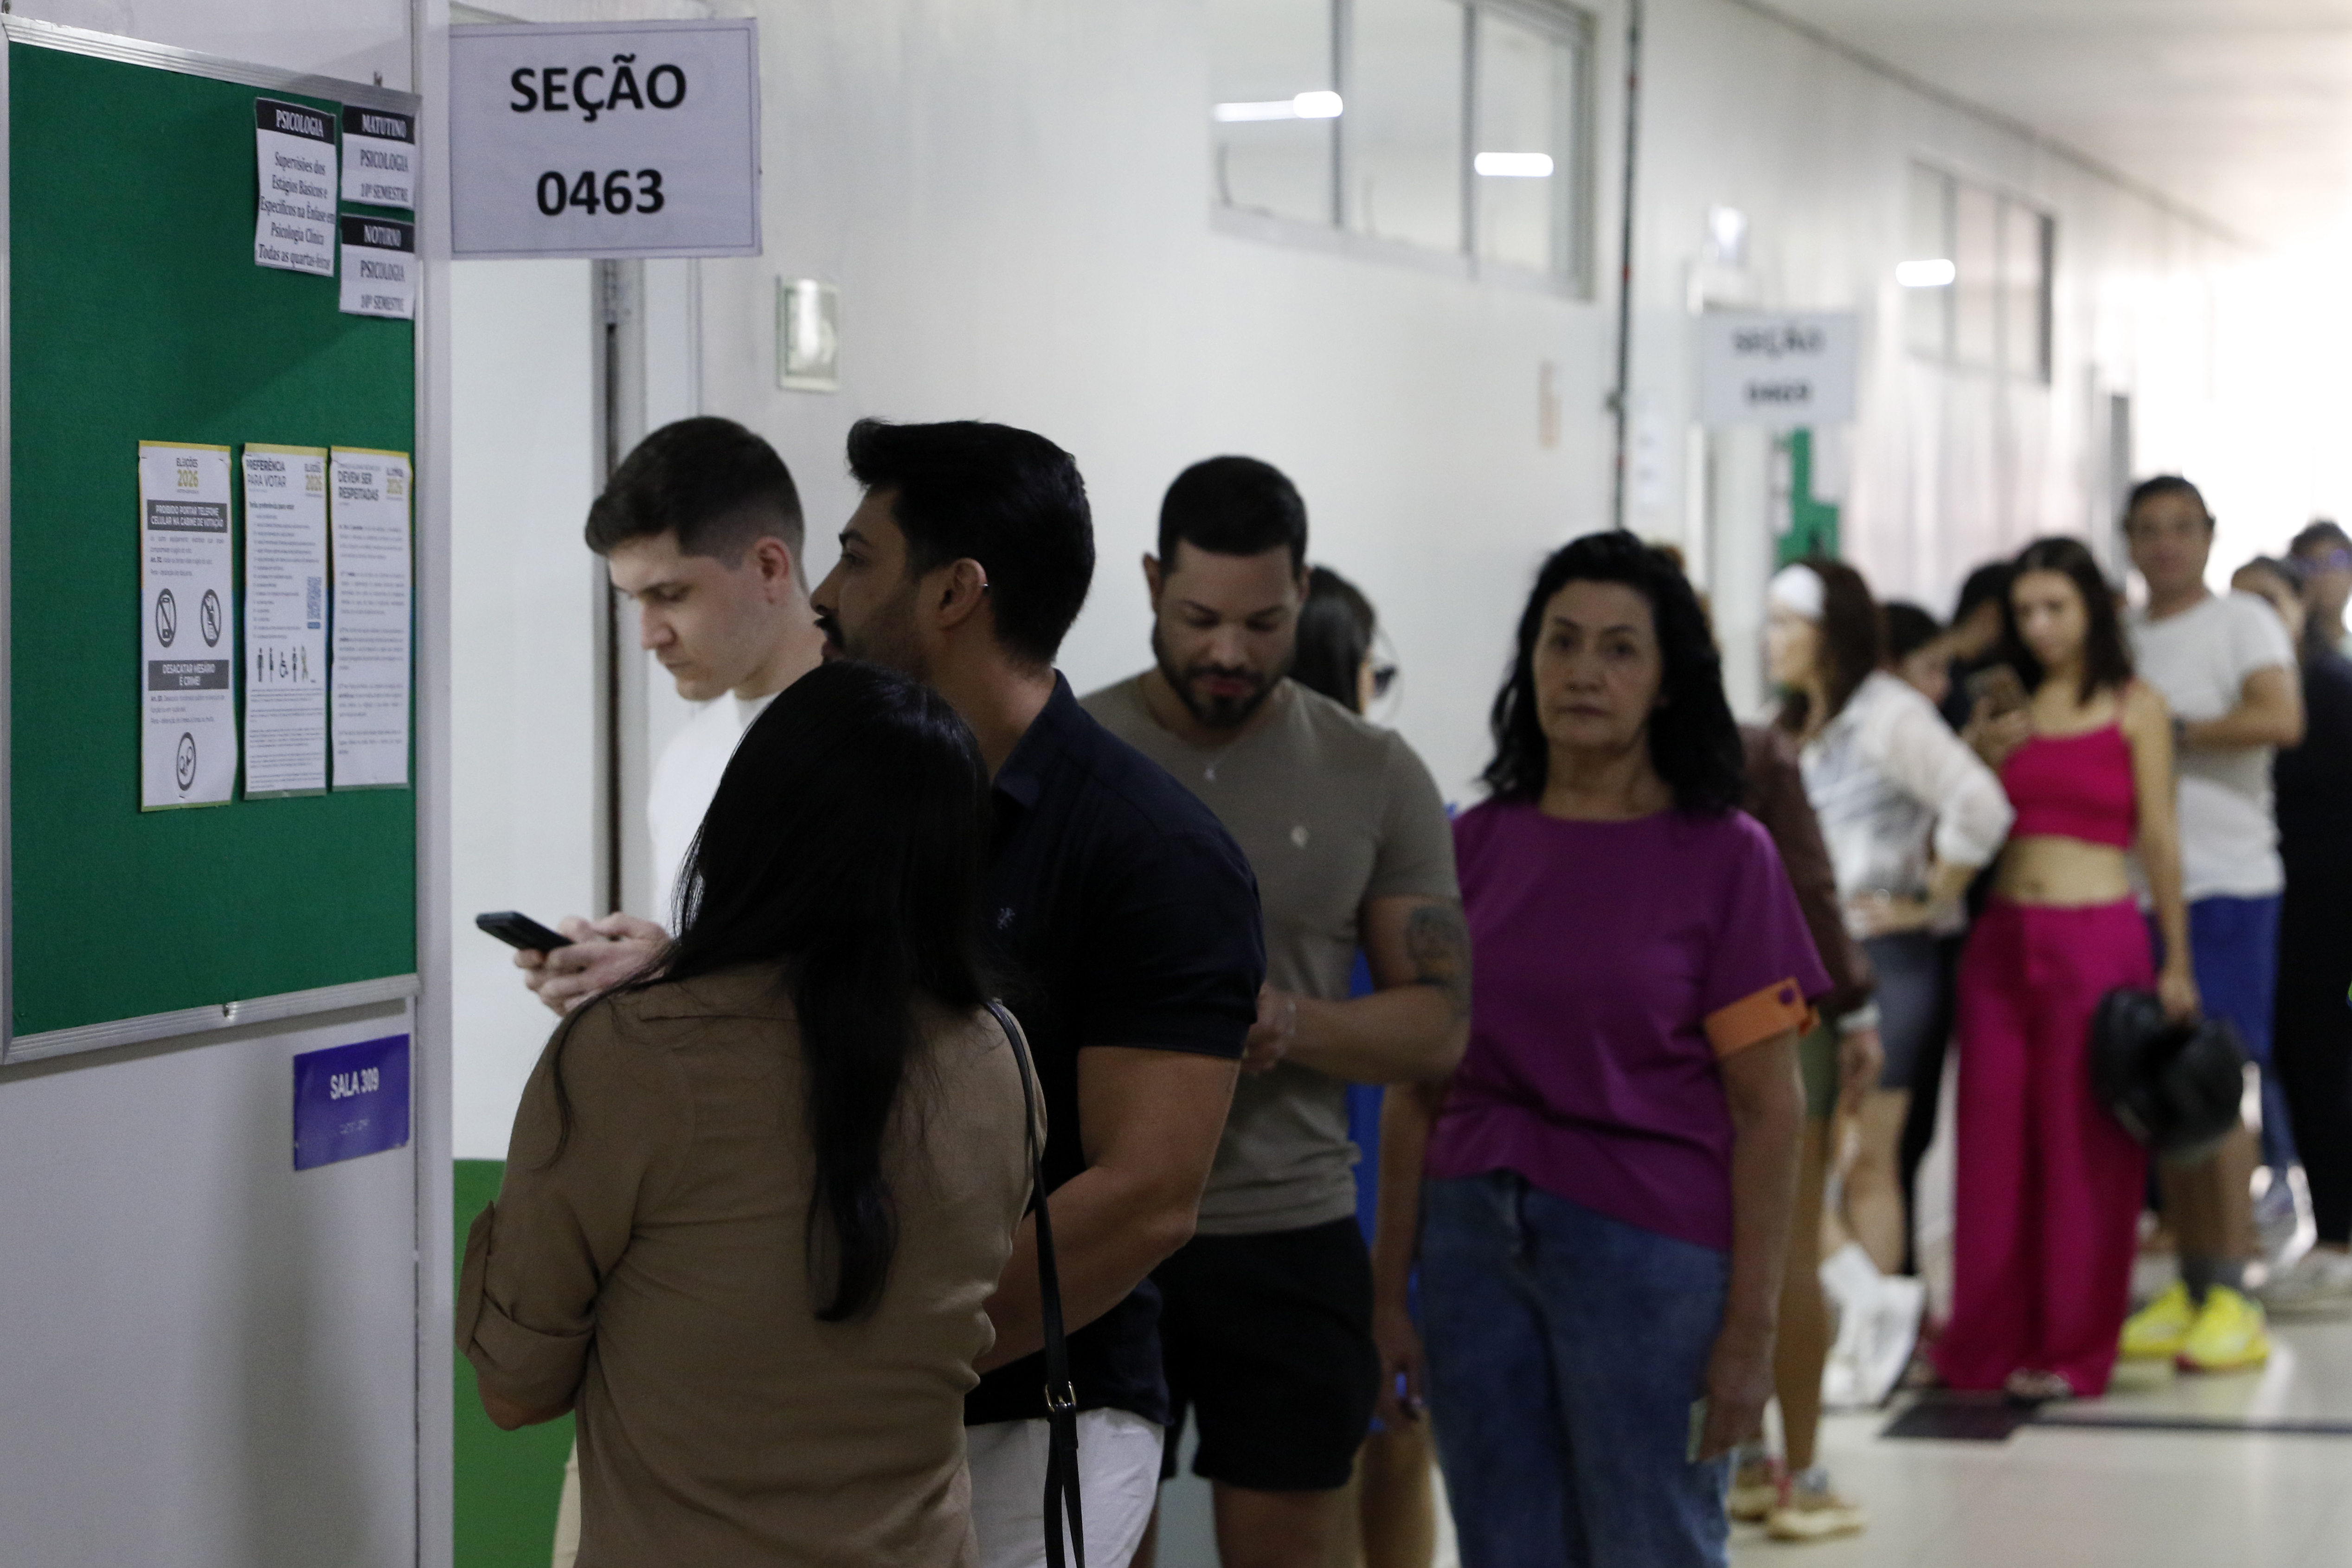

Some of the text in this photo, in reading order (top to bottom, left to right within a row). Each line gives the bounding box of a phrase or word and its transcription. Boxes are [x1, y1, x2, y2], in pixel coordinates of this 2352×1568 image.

[511, 53, 687, 122] SEÇÃO
[276, 109, 324, 137] PSICOLOGIA
[362, 114, 406, 138] MATUTINO
[275, 152, 313, 173] Supervisões
[360, 149, 408, 172] PSICOLOGIA
[272, 174, 298, 196] Estágios
[299, 180, 323, 199] Básicos
[373, 184, 409, 202] SEMESTRE
[537, 168, 665, 216] 0463
[259, 196, 296, 216] Específicos
[297, 207, 305, 218] na
[271, 222, 304, 244] Psicologia
[259, 244, 280, 261] Todas
[281, 251, 289, 263] as
[360, 260, 405, 283] PSICOLOGIA
[176, 456, 198, 469] ELEIÇÕES
[246, 458, 286, 472] PREFERÊNCIA
[177, 469, 199, 488] 2026
[247, 474, 286, 488] PARA VOTAR
[151, 515, 173, 525] CELULAR
[173, 517, 180, 526] NA
[197, 518, 204, 527] DE
[155, 505, 219, 517] PROIBIDO PORTAR TELEFONE
[162, 663, 193, 674] DESACATAR
[330, 1067, 379, 1100] SALA 309
